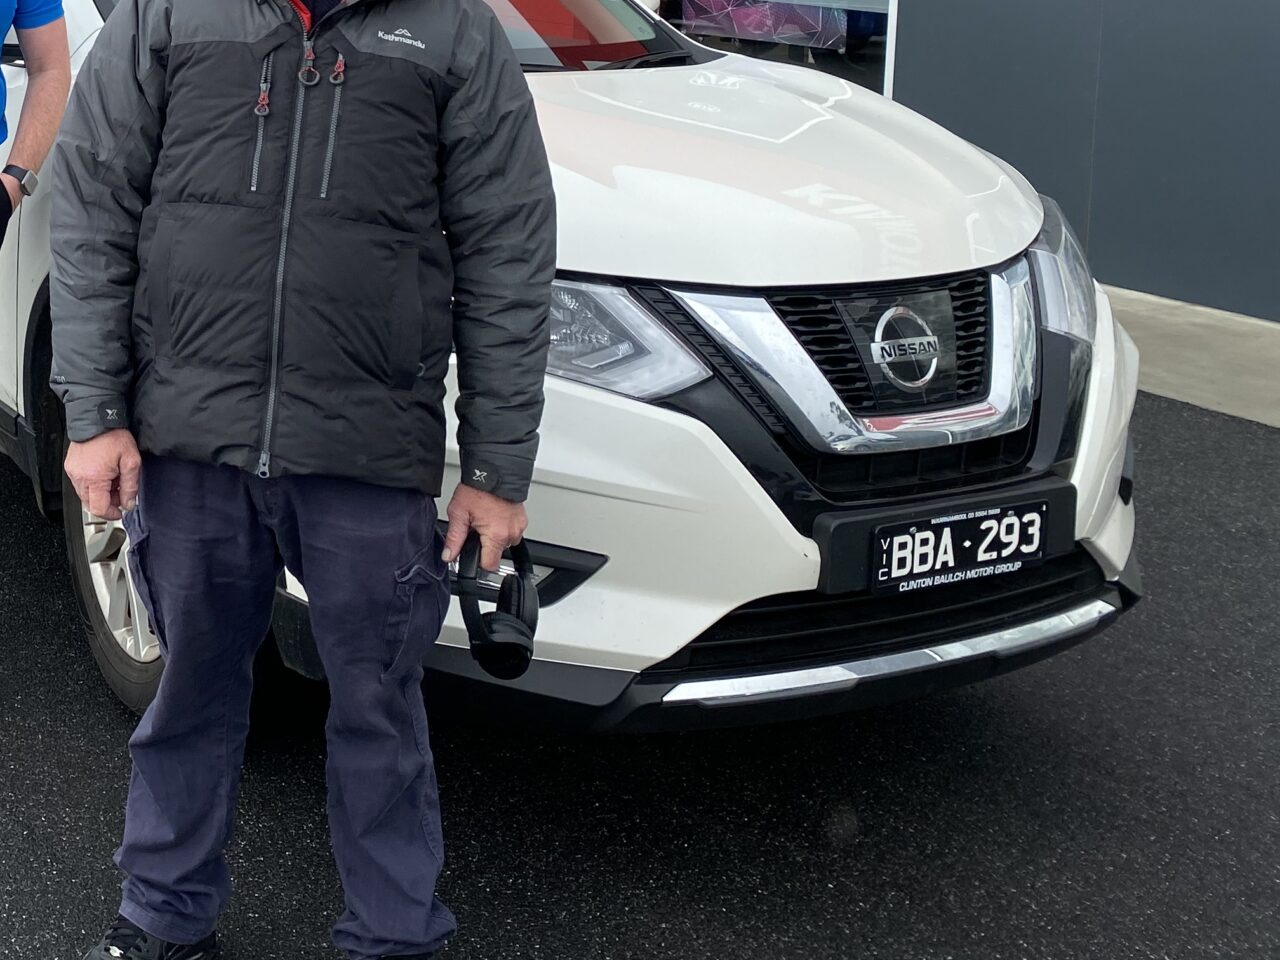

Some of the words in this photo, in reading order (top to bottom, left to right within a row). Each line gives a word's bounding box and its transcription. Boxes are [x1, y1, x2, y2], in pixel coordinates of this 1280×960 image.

[378, 30, 426, 49] Kathmandu
[880, 340, 938, 358] NISSAN
[891, 526, 955, 578] BBA
[977, 512, 1042, 562] 293
[899, 576, 933, 592] CLINTON
[933, 571, 966, 586] BAULCH
[965, 566, 994, 580] MOTOR
[994, 561, 1023, 574] GROUP
